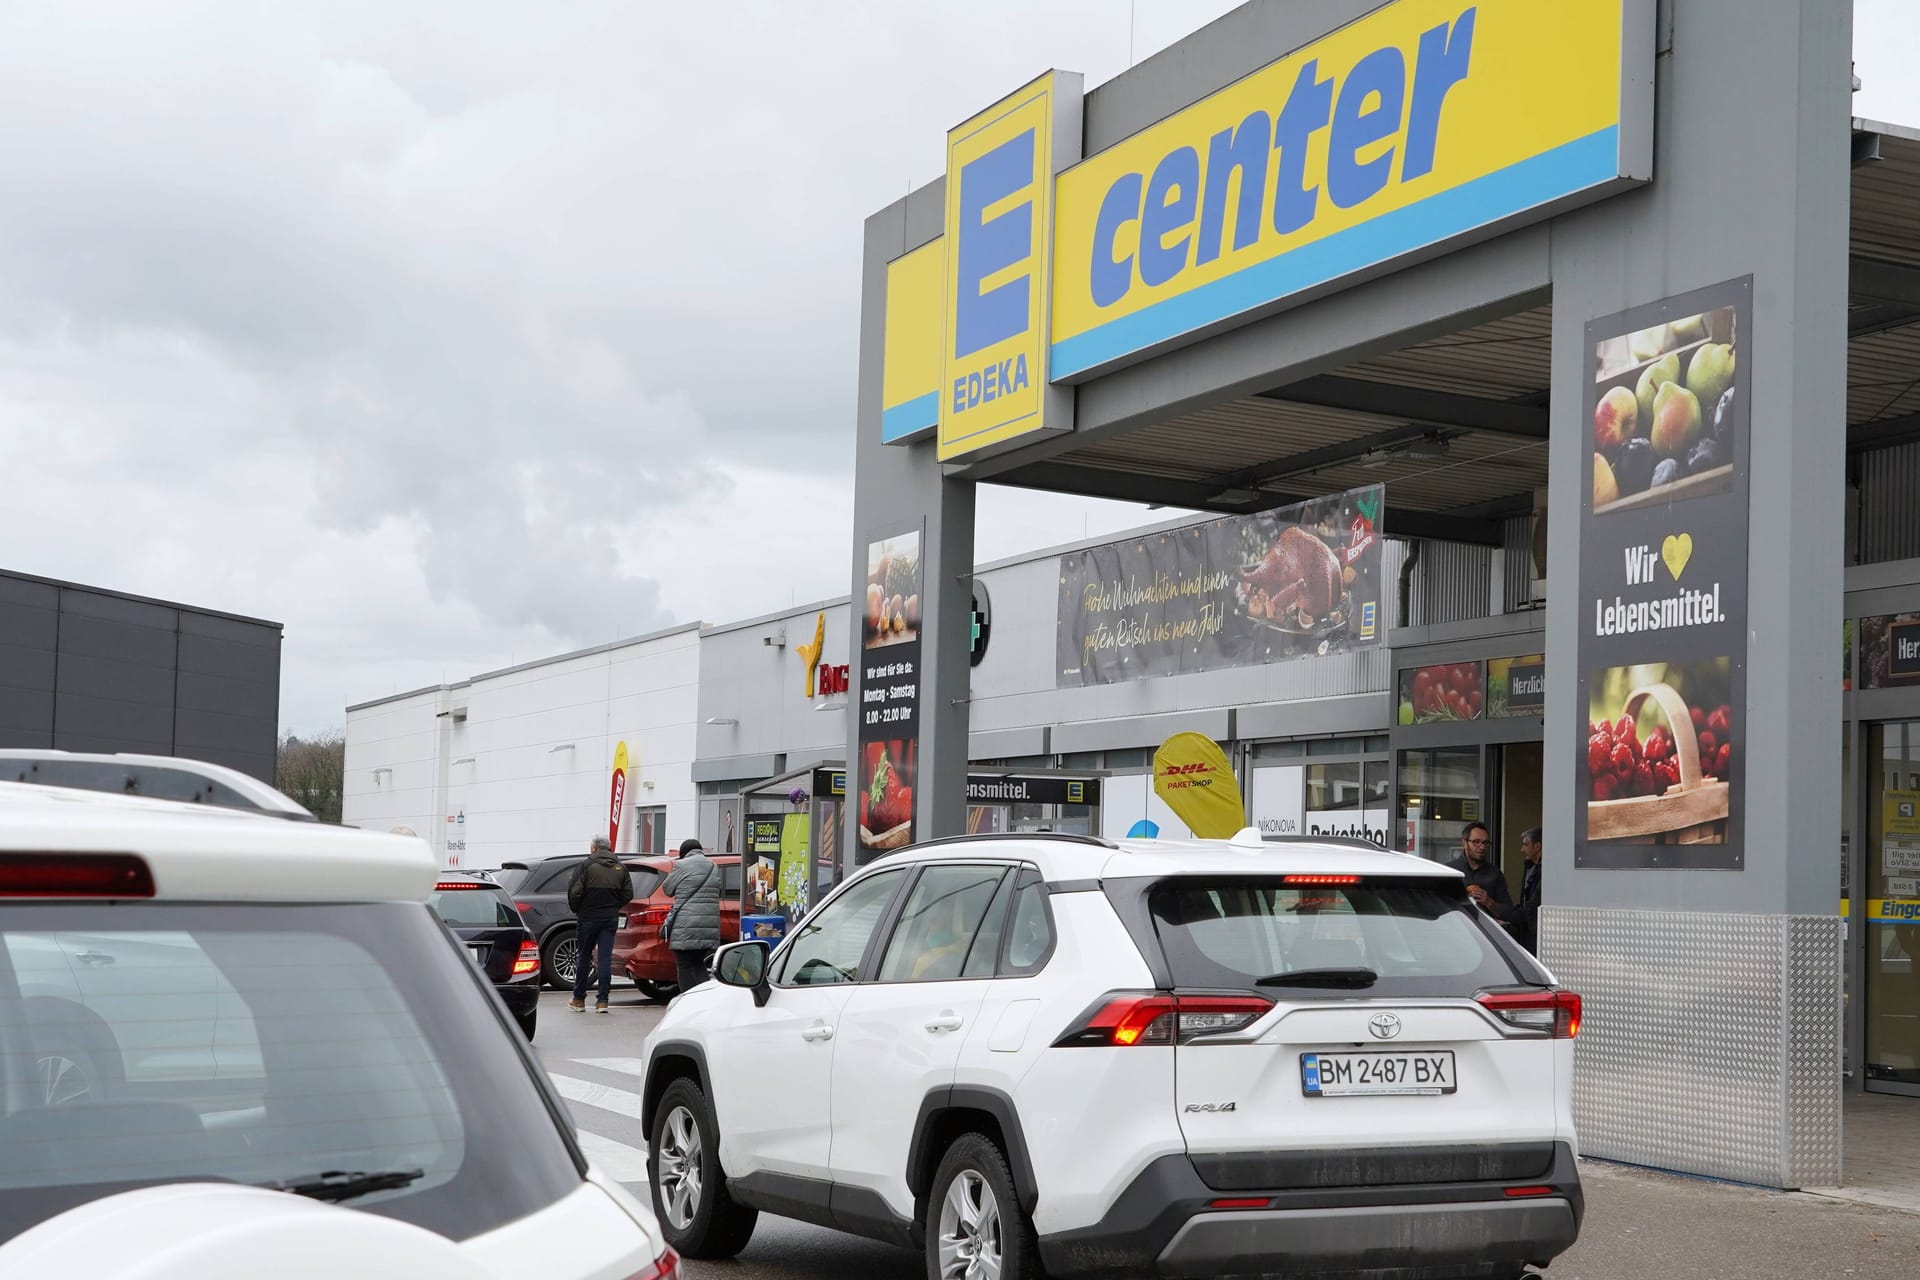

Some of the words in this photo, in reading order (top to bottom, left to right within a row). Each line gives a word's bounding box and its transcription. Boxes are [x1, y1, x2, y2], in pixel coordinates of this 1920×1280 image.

[1091, 6, 1476, 308] center
[955, 127, 1035, 360] E
[953, 353, 1030, 415] EDEKA
[1625, 545, 1658, 586] Wir
[1181, 563, 1202, 599] und
[1203, 570, 1229, 593] einen
[1596, 582, 1726, 637] Lebensmittel.
[1115, 611, 1150, 653] Rutsch
[1153, 621, 1170, 642] ins
[1172, 618, 1197, 641] neue
[1197, 600, 1225, 643] Jahr!
[1898, 637, 1920, 660] Her
[867, 667, 875, 679] Wir
[876, 665, 887, 678] sind
[887, 663, 896, 676] für
[896, 662, 904, 675] Sie
[864, 688, 886, 702] Montag
[890, 684, 916, 699] Samstag
[866, 710, 879, 724] 8.00
[883, 708, 899, 722] 22.00
[900, 706, 912, 720] Uhr
[1166, 762, 1209, 776] DHL
[1168, 779, 1213, 790] PAKETSHOP
[1307, 1077, 1319, 1087] UA
[1320, 1059, 1352, 1084] BM
[1358, 1058, 1408, 1084] 2487
[1415, 1057, 1447, 1083] BX
[1184, 1101, 1237, 1114] RAV4
